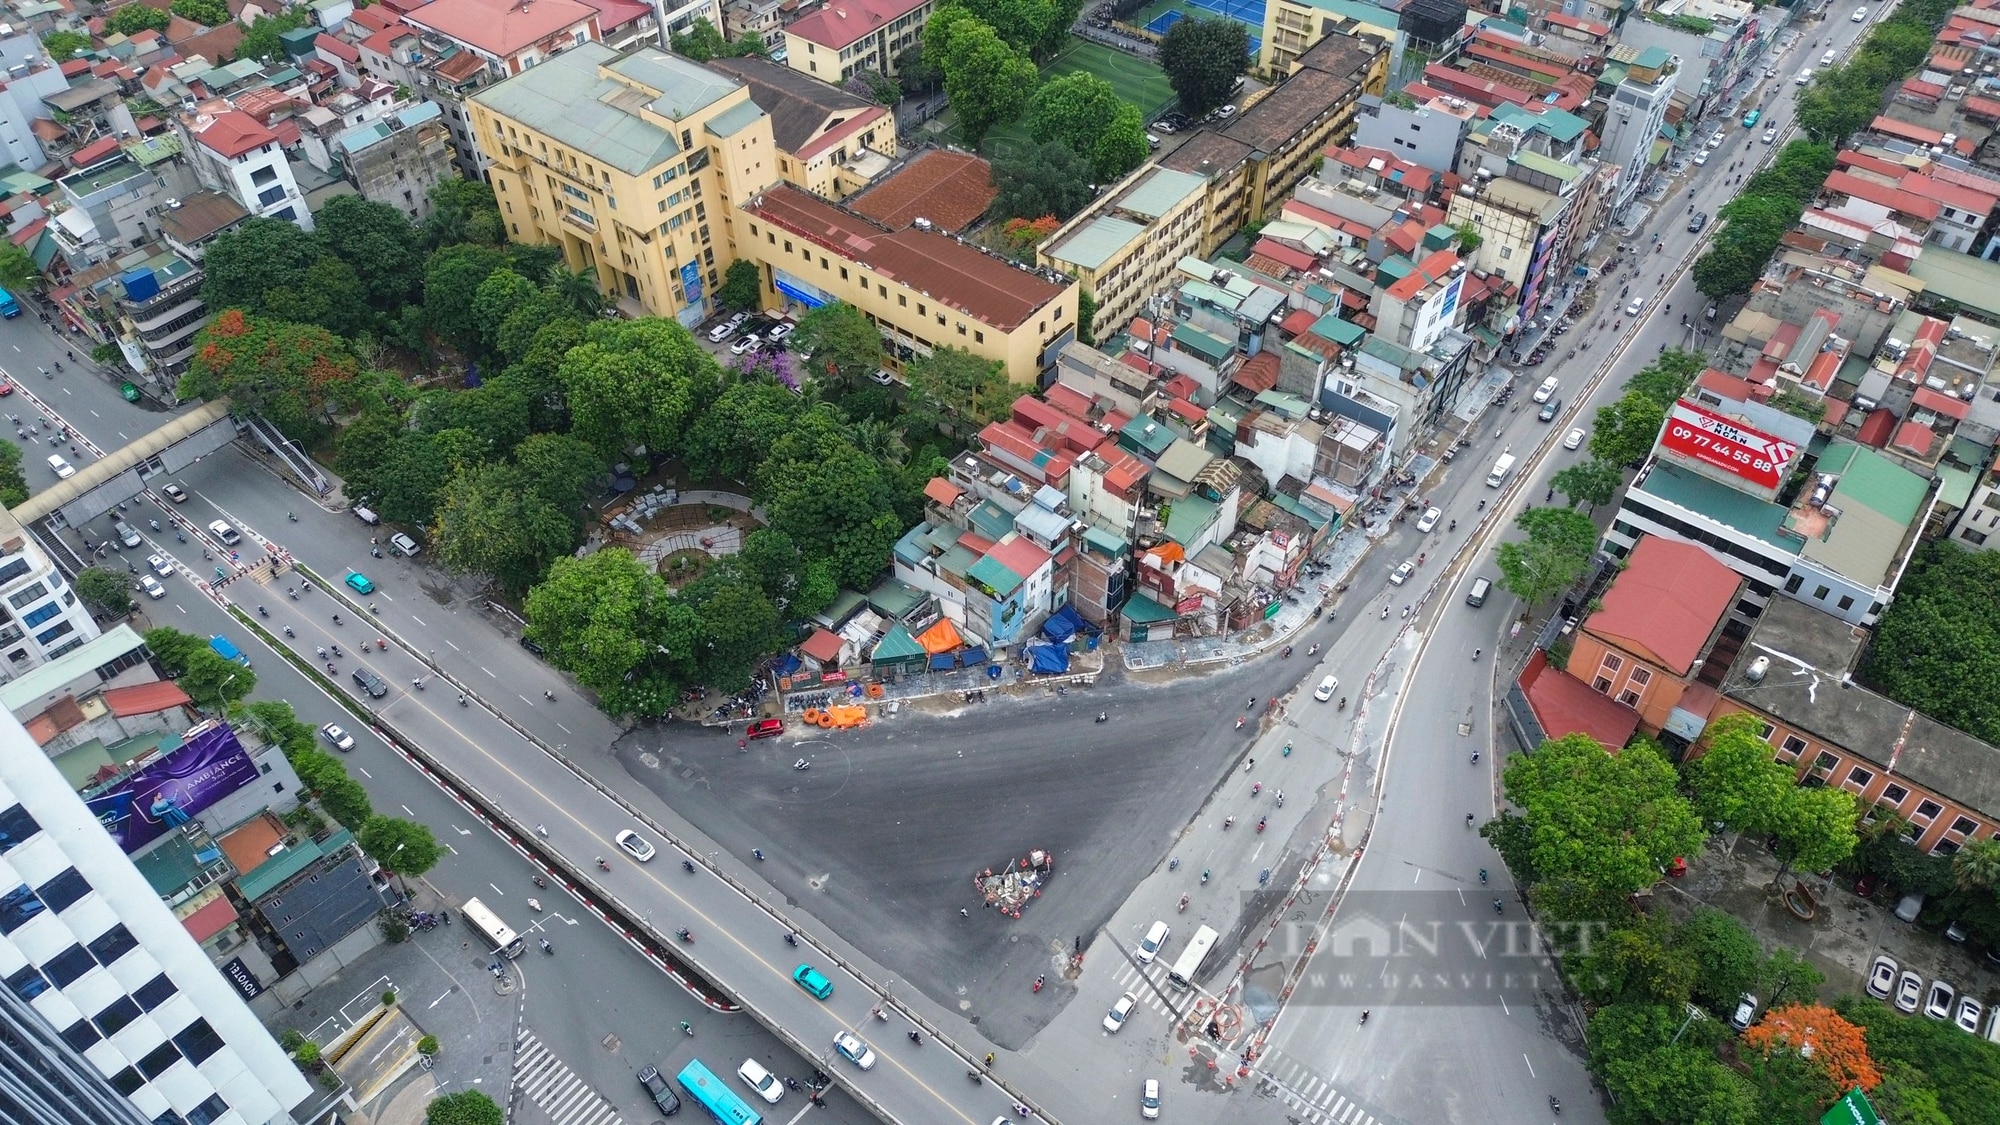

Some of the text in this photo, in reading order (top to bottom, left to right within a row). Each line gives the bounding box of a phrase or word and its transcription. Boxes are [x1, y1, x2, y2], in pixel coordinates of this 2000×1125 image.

[1716, 422, 1739, 435] KIM
[1672, 426, 1772, 472] 09 77 44 55 88
[186, 753, 243, 791] AMBIANCE
[230, 962, 257, 997] NOVOTEL
